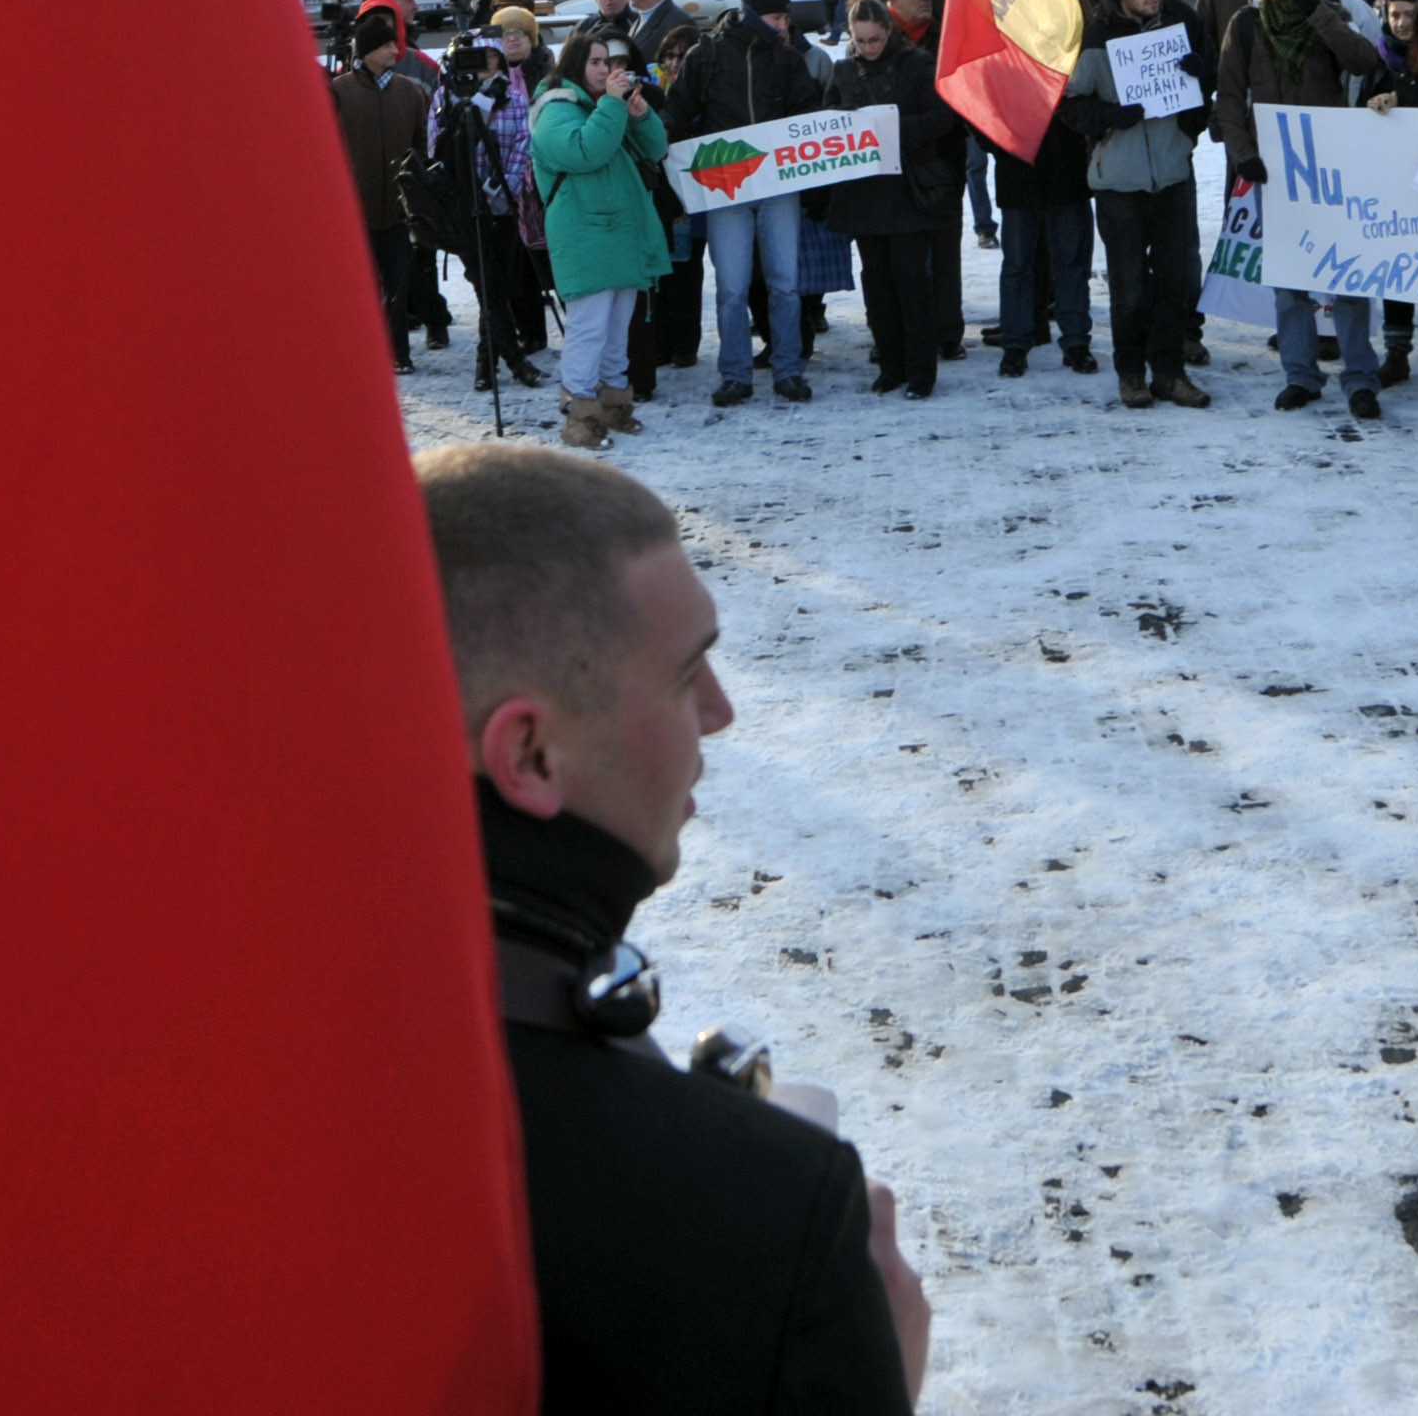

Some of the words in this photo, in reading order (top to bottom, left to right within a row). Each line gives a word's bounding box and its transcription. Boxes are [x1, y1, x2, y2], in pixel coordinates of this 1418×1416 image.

[1141, 34, 1188, 61] STRADĂ
[1140, 57, 1182, 80] PENTR
[1125, 74, 1188, 103] ROMÂNIA
[787, 113, 853, 139] Salvați
[774, 129, 880, 167] ROSIA
[777, 149, 882, 181] MONTANA
[1275, 111, 1343, 206] Nu
[1346, 195, 1379, 221] ne
[1299, 229, 1315, 254] la
